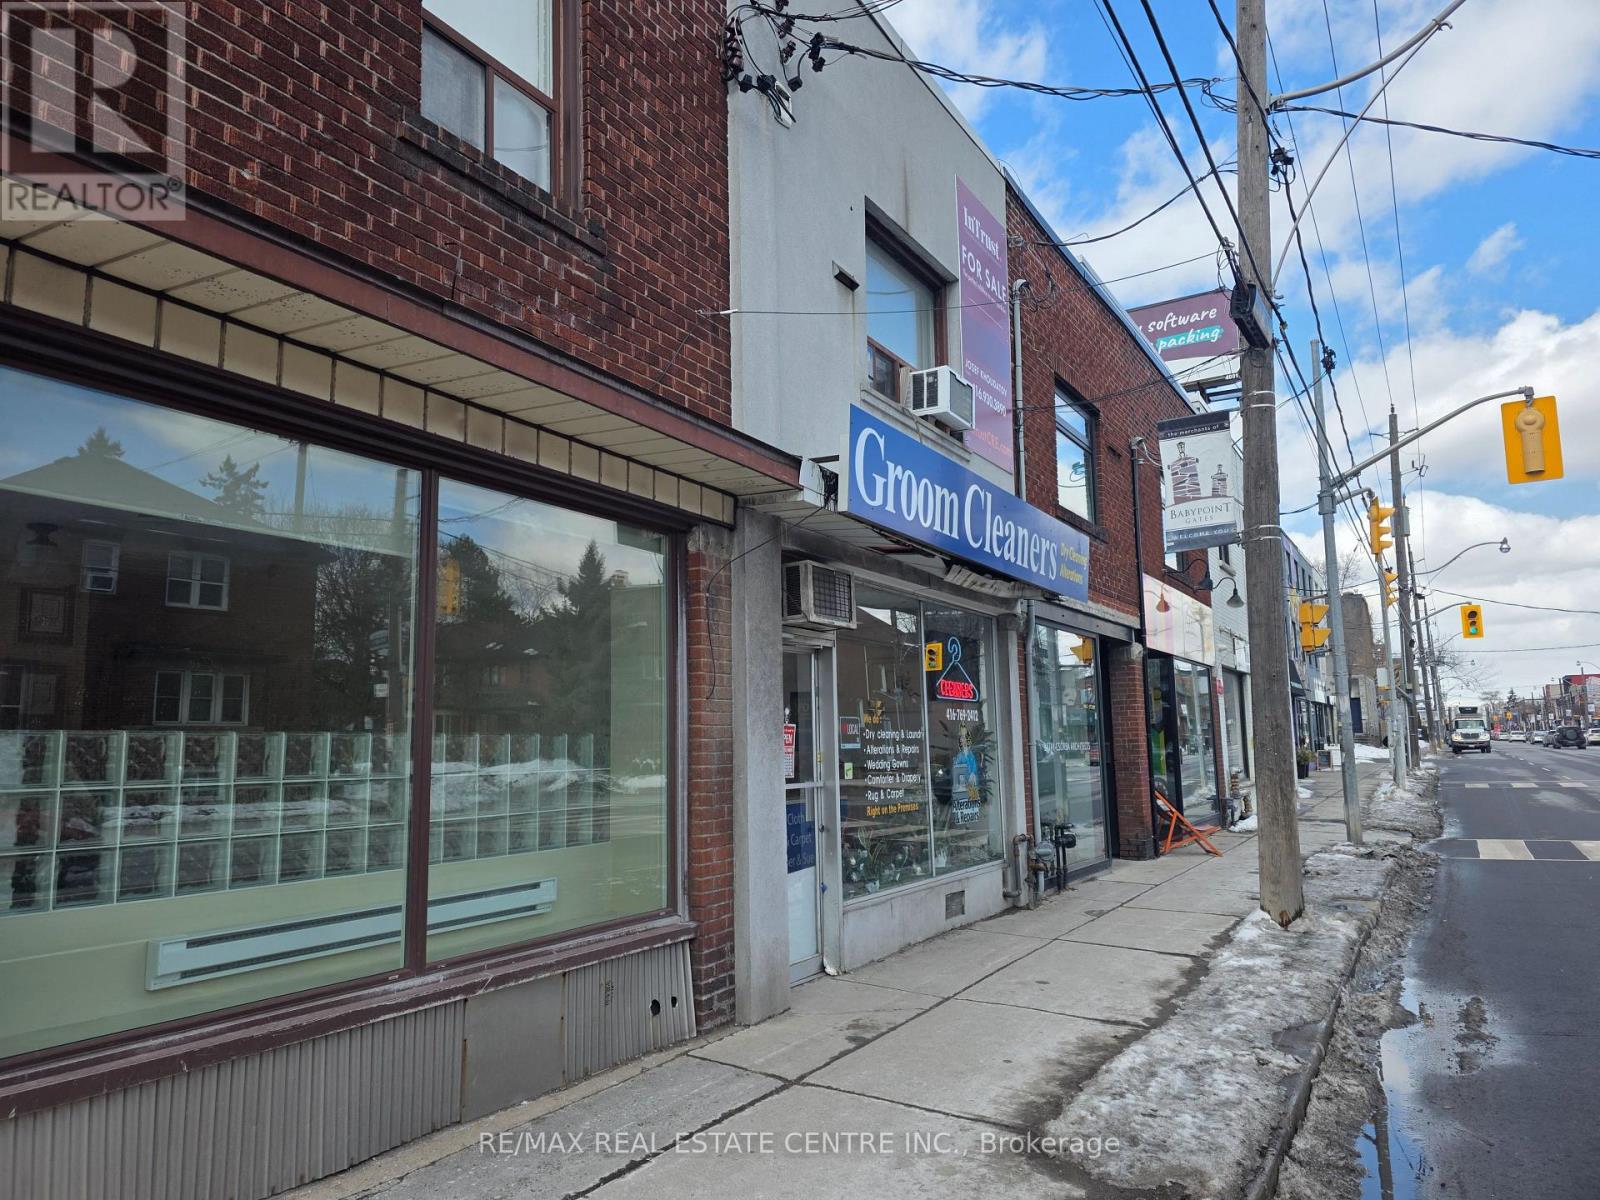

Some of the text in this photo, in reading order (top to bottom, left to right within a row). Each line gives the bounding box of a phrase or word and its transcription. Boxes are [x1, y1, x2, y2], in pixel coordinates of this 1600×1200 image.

[962, 245, 982, 280] FOR
[985, 269, 1007, 304] SALE
[1148, 308, 1217, 332] software
[1158, 328, 1220, 354] packing
[1180, 426, 1211, 436] merchants
[854, 427, 1058, 580] Groom Cleaners
[1185, 515, 1214, 525] GATES
[865, 729, 875, 740] Dry
[877, 730, 899, 741] cleaning
[900, 729, 905, 739] &
[866, 745, 894, 755] Alterations
[896, 745, 900, 754] &
[901, 744, 920, 755] Repairs
[866, 759, 909, 771] Wedding Gowns
[867, 773, 921, 785] Comforter & Drapery
[867, 788, 905, 802] Rug & Carpet
[866, 802, 919, 818] Right on the Premises
[953, 800, 981, 812] Alterations
[960, 810, 979, 823] Repairs
